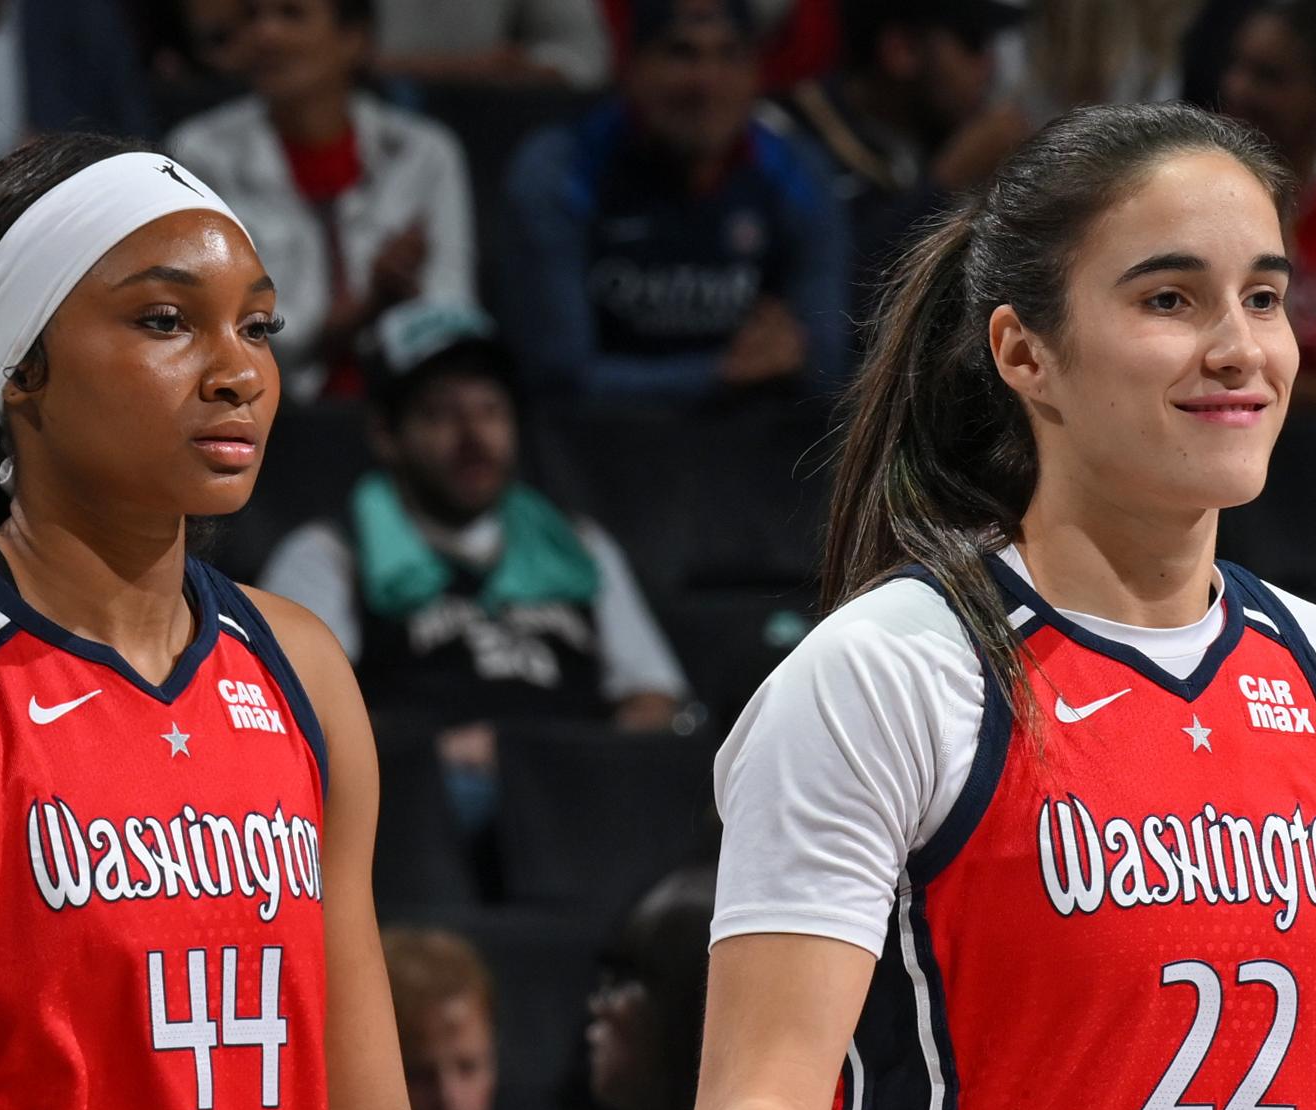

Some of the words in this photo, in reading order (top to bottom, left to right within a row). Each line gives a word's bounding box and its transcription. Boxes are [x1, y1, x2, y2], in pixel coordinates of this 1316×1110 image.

[217, 679, 268, 708] CAR
[1238, 674, 1295, 705] CAR
[228, 704, 287, 735] max
[1247, 702, 1316, 734] max
